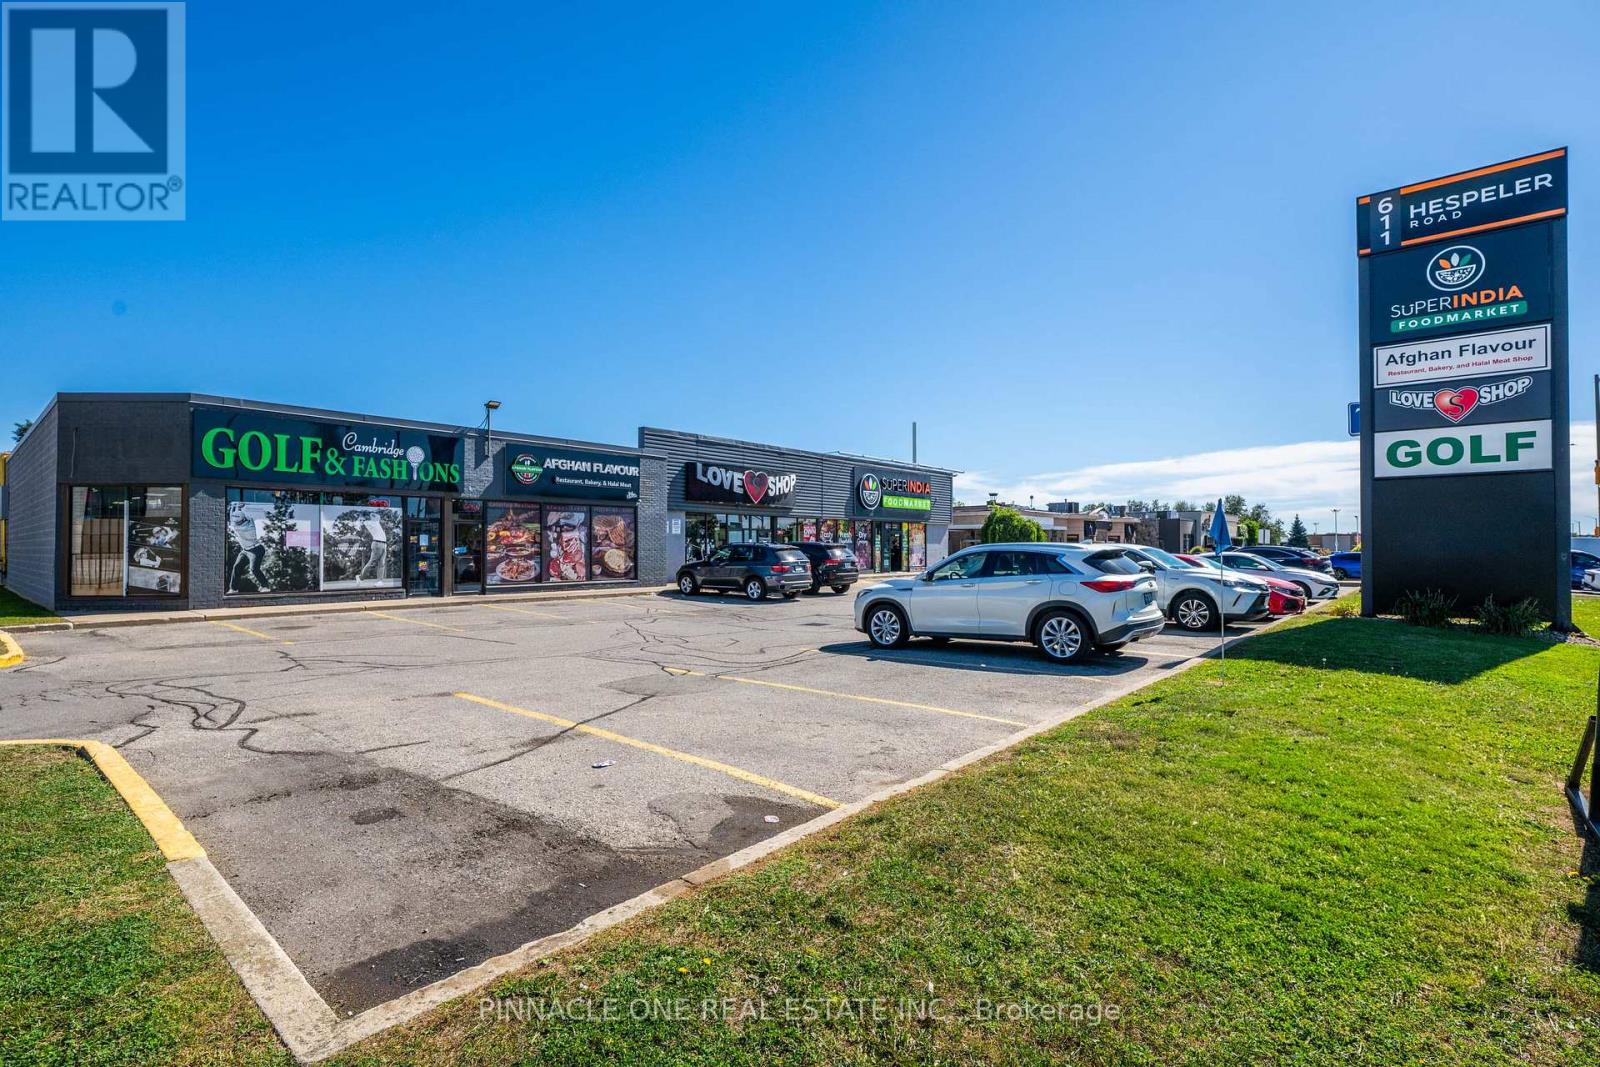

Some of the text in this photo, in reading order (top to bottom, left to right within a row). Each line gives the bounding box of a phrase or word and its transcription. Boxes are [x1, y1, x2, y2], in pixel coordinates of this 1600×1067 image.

[1409, 173, 1553, 219] HESPELER
[1409, 211, 1462, 228] ROAD
[1398, 304, 1520, 330] FOODMARKET
[1385, 337, 1537, 367] Afghan Flavour
[1387, 367, 1427, 377] Restaurant,
[1428, 364, 1455, 372] Bakery,
[1512, 355, 1534, 363] Shop
[1390, 391, 1435, 409] LOVE
[1479, 377, 1532, 404] SHOP
[201, 427, 323, 475] GOLF
[324, 447, 347, 476] &
[342, 432, 405, 457] Cambridge
[1386, 430, 1537, 468] GOLF
[543, 458, 591, 472] AFGHAN
[592, 462, 640, 477] FLAVOUR
[696, 462, 744, 494] LOVE
[767, 473, 797, 497] SHOP
